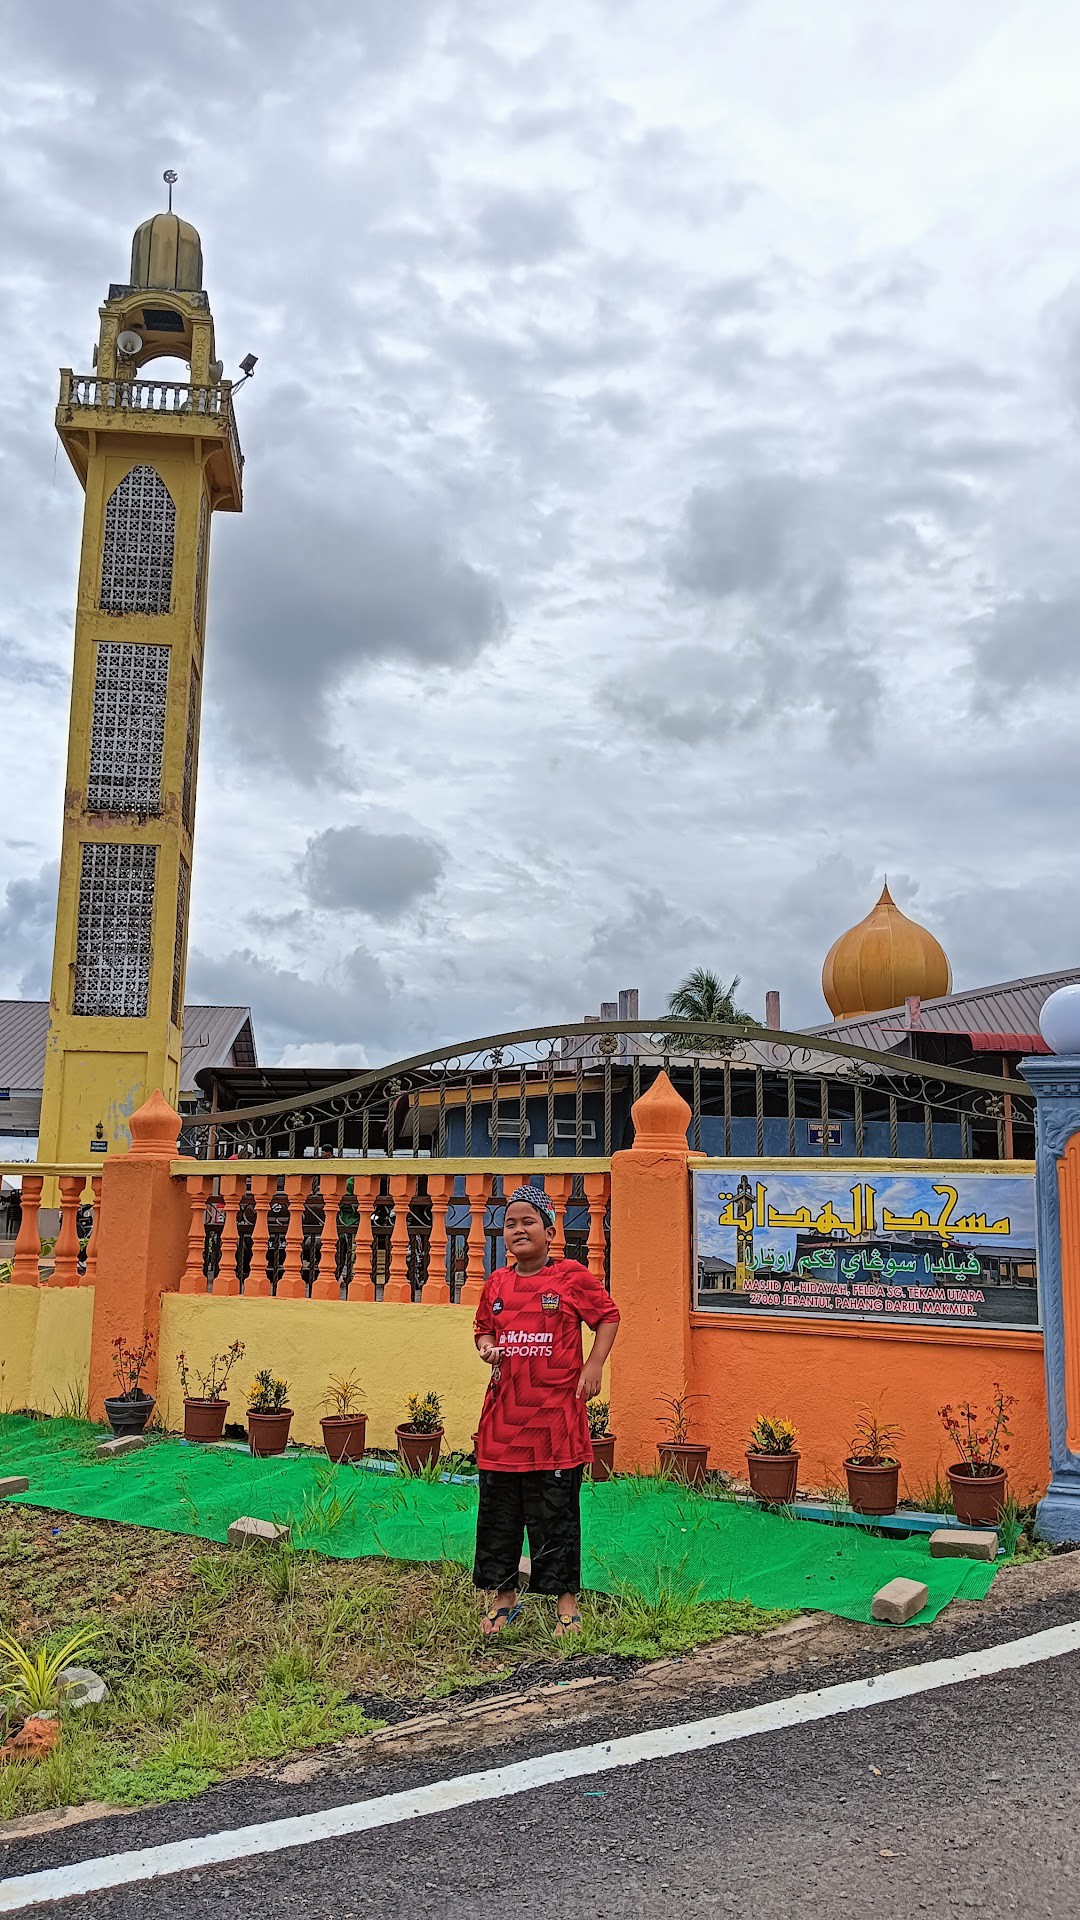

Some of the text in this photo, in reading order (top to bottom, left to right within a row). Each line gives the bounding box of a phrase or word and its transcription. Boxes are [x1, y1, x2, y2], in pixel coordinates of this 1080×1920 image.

[718, 1182, 1011, 1248] مسجد الهداية
[924, 1252, 981, 1281] فيلدا
[742, 1279, 985, 1302] MASJID AL-HIDAYAH, FELDA SG. TEKAM UTARA
[749, 1292, 977, 1317] 27060 JERANTUT, PAHANG DARUL MAKMUR.
[505, 1345, 553, 1357] SPORTS
